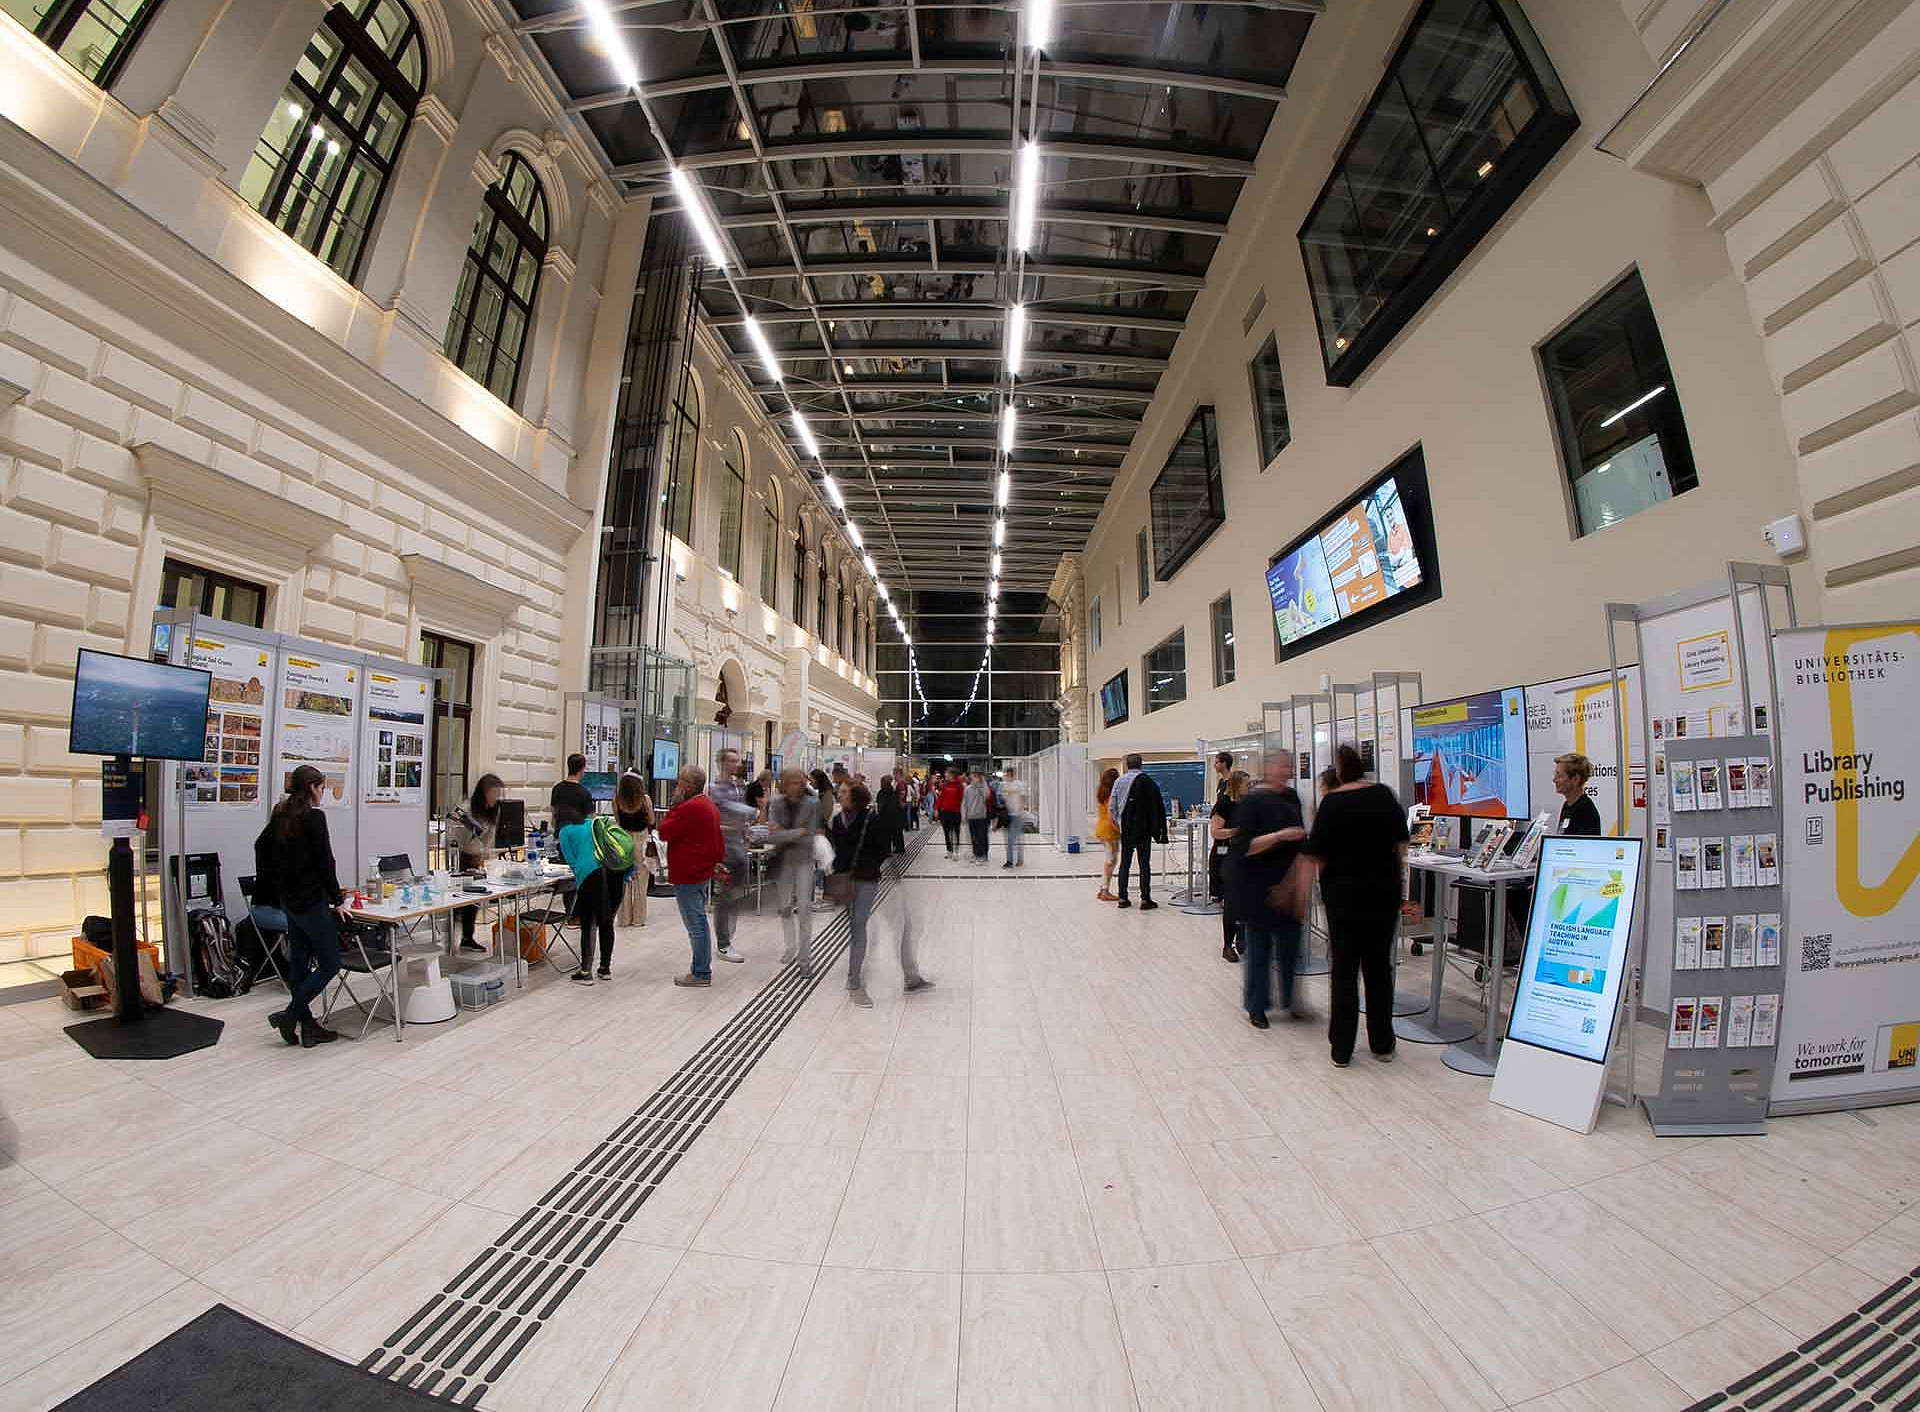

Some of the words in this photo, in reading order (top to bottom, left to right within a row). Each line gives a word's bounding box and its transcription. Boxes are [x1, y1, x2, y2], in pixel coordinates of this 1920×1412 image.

[1795, 651, 1905, 670] UNIVERSITÄTS-
[1797, 667, 1885, 685] BIBLIOTHEK
[1562, 713, 1602, 725] BIBLIOTHEK
[1803, 750, 1874, 775] Library
[1804, 776, 1905, 804] Publishing
[1550, 930, 1580, 940] TEACHING
[1551, 923, 1577, 932] ENGLISH
[1577, 926, 1612, 937] LANGUAGE
[1798, 1043, 1815, 1056] We
[1818, 1038, 1848, 1053] work
[1846, 1036, 1866, 1052] for
[1795, 1052, 1864, 1069] tomorrow
